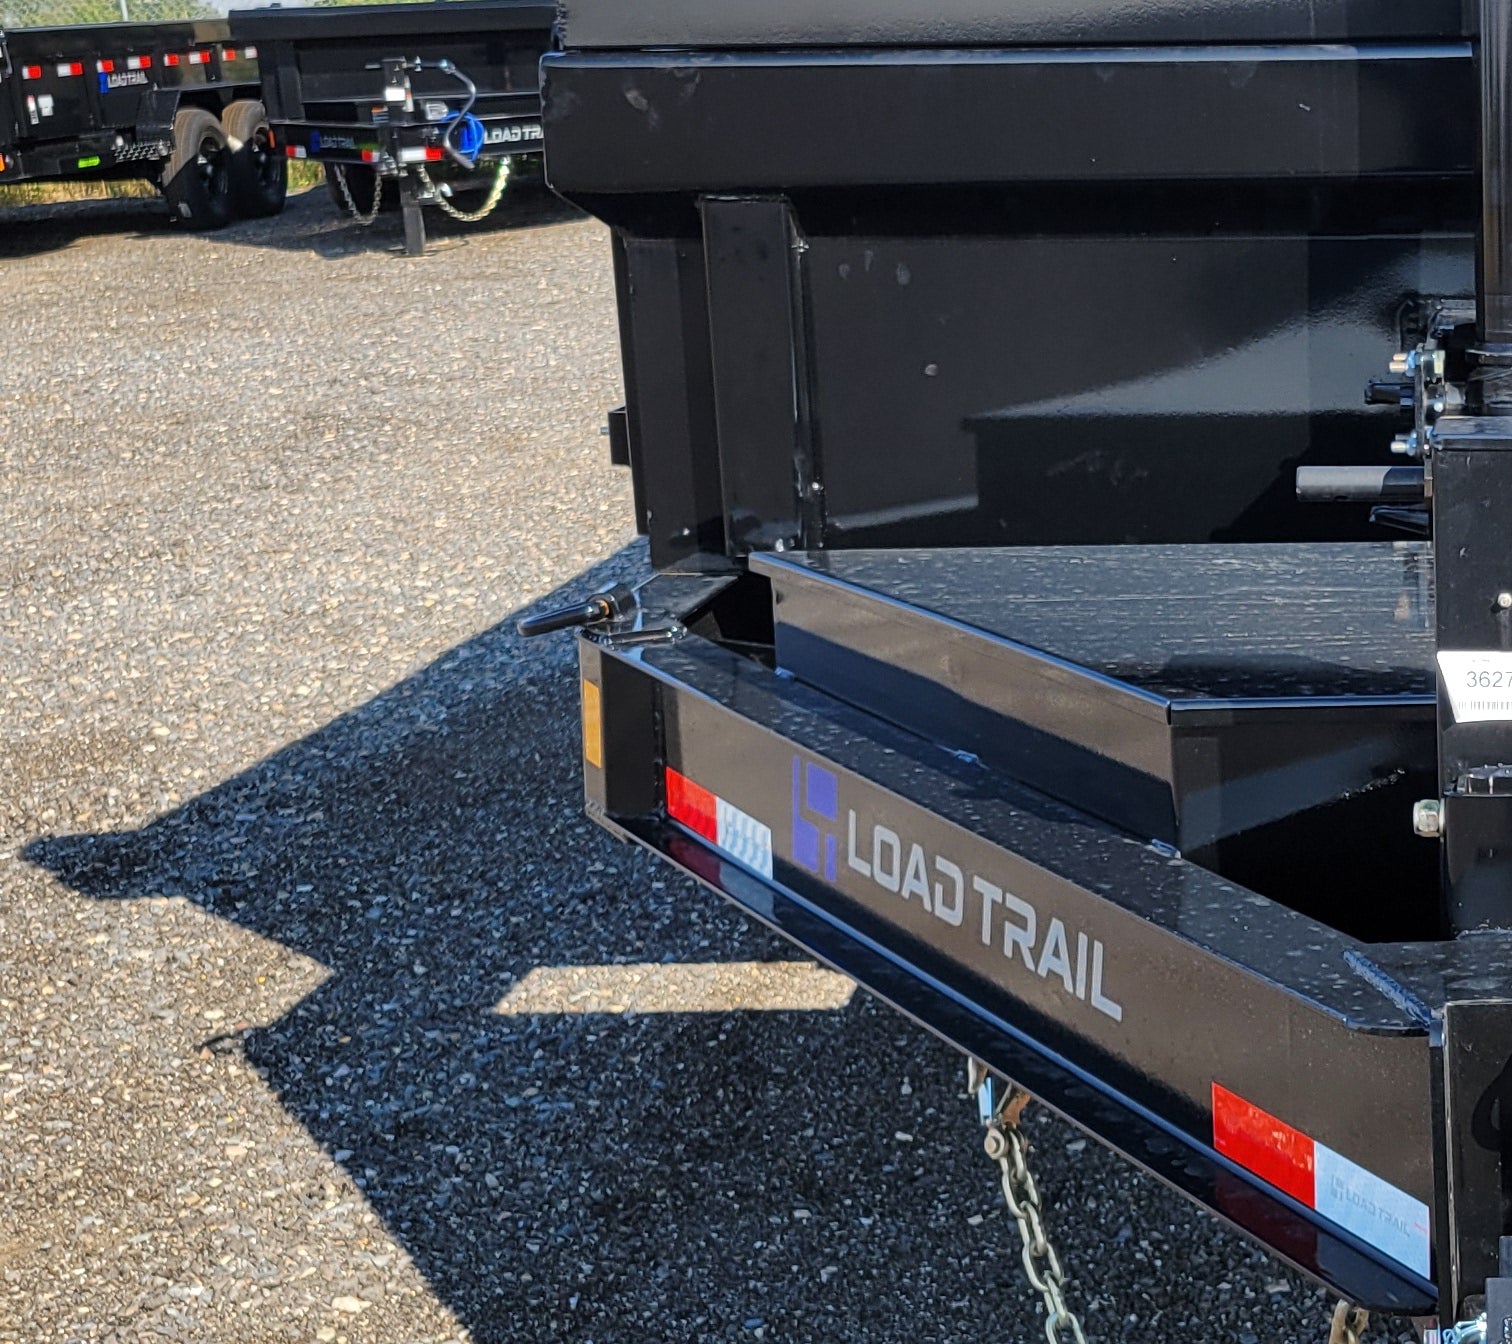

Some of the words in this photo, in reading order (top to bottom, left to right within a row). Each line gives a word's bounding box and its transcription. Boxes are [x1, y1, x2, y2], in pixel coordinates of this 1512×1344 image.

[484, 125, 521, 145] LOAD
[848, 808, 964, 927] LOAD
[972, 874, 1123, 1022] TRAIL
